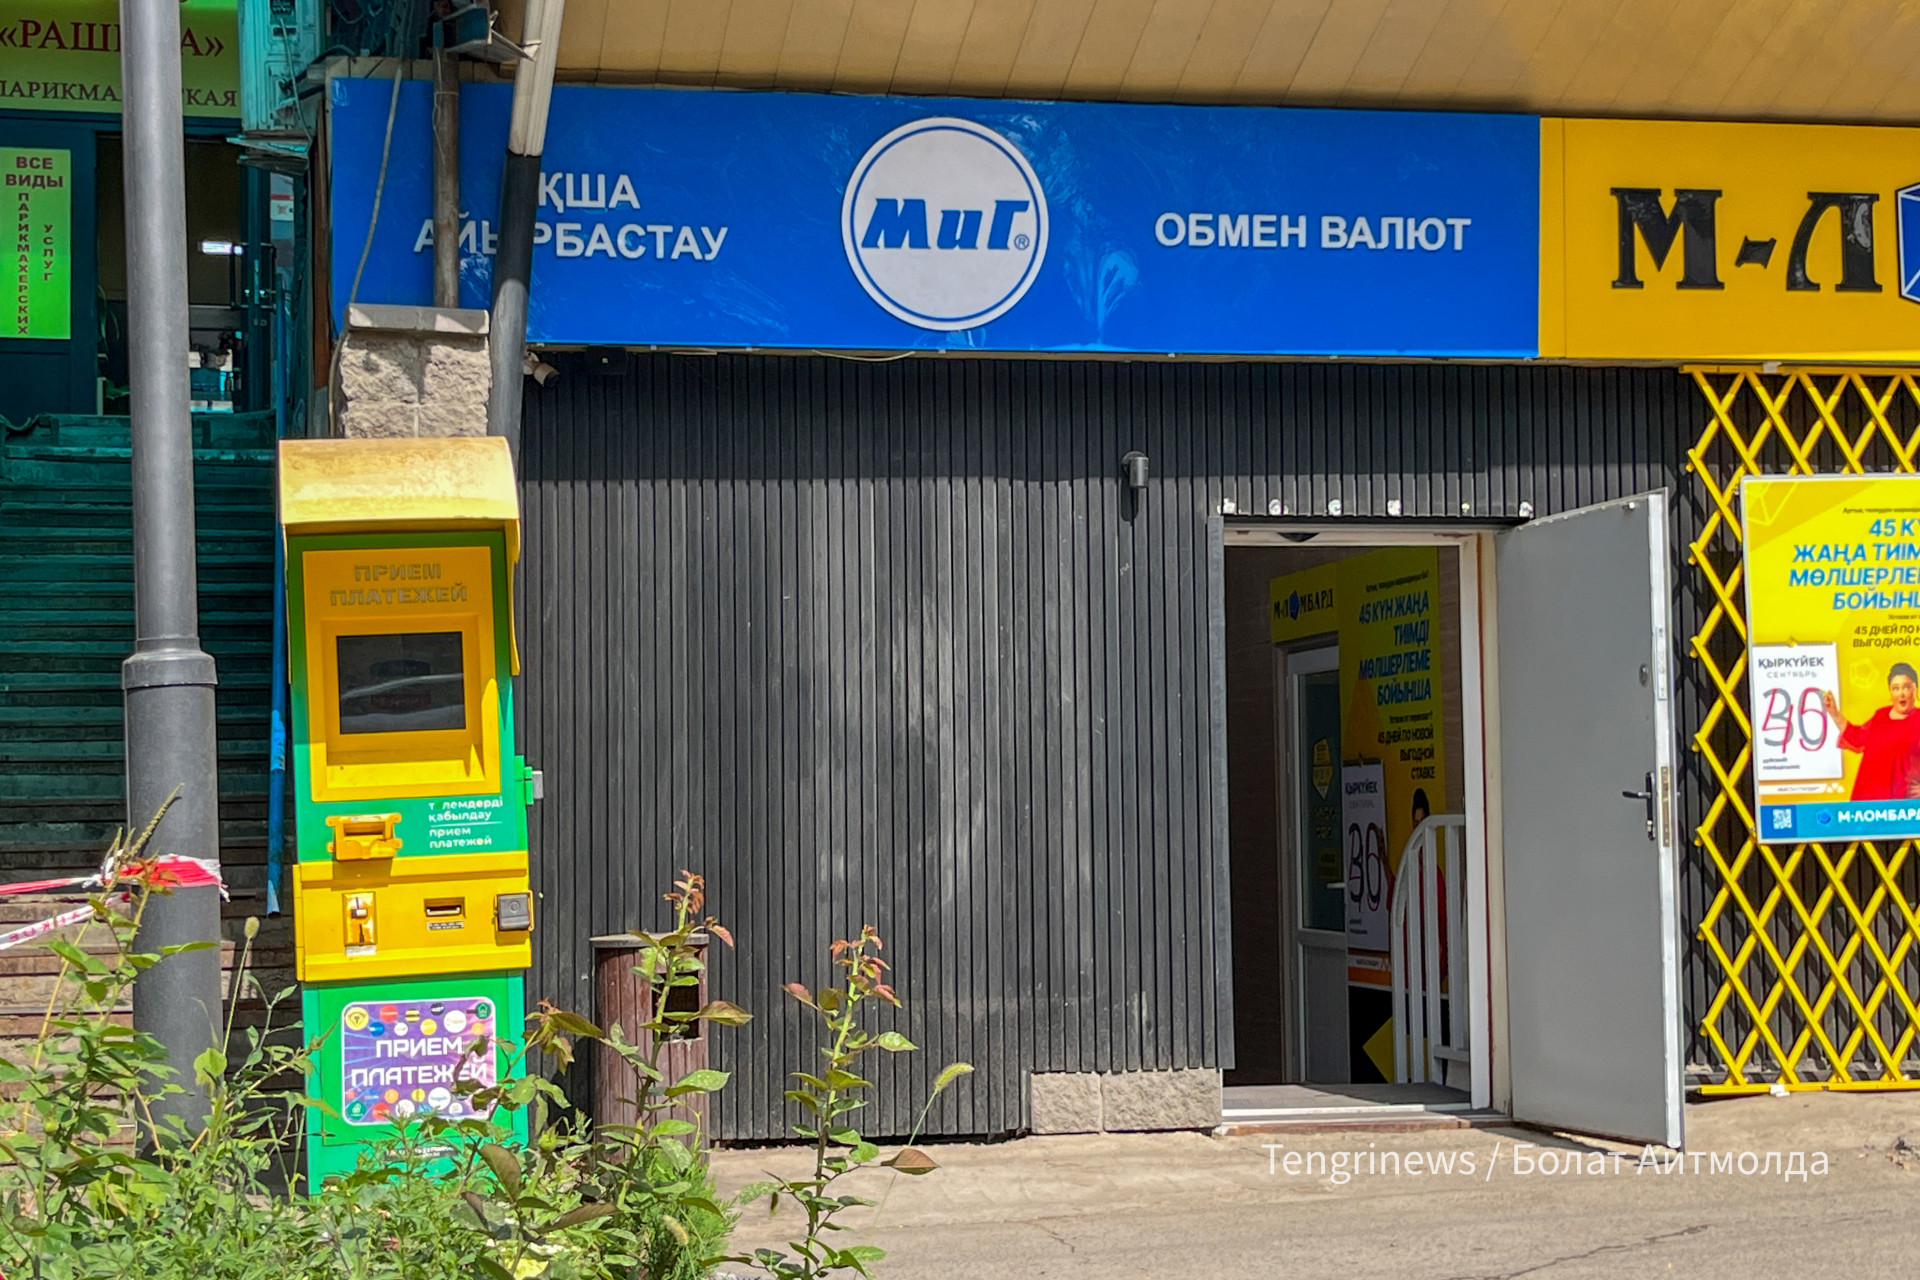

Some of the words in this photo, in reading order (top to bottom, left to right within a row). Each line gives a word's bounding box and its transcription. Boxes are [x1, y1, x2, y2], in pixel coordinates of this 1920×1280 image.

[0, 19, 224, 57] «РАША»
[16, 156, 53, 169] ВСЕ
[5, 174, 63, 190] ВИДЫ
[413, 211, 729, 262] АЙРБАСТАУ
[1154, 212, 1307, 249] ОБМЕН
[1320, 215, 1473, 251] ВАЛЮТ
[17, 192, 30, 335] ПАРИКМАХЕРСКИХ
[43, 224, 54, 281] УСЛУГ
[1868, 518, 1896, 537] 45
[1792, 543, 1867, 566] ЖАҢА
[354, 563, 442, 582] ПРИЕМ
[1788, 567, 1920, 587] МӨЛШЕРЛЕ
[330, 583, 468, 606] ПЛАТЕЖЕЙ
[1359, 601, 1371, 624] 45
[1394, 590, 1429, 618] ЖАҢА
[1854, 626, 1868, 636] 45
[1869, 623, 1898, 637] ДНЕЙ
[1899, 625, 1915, 635] ПО
[1377, 678, 1432, 706] БОЙЫНША
[429, 827, 471, 839] прием
[375, 1037, 464, 1058] ПРИЕМ
